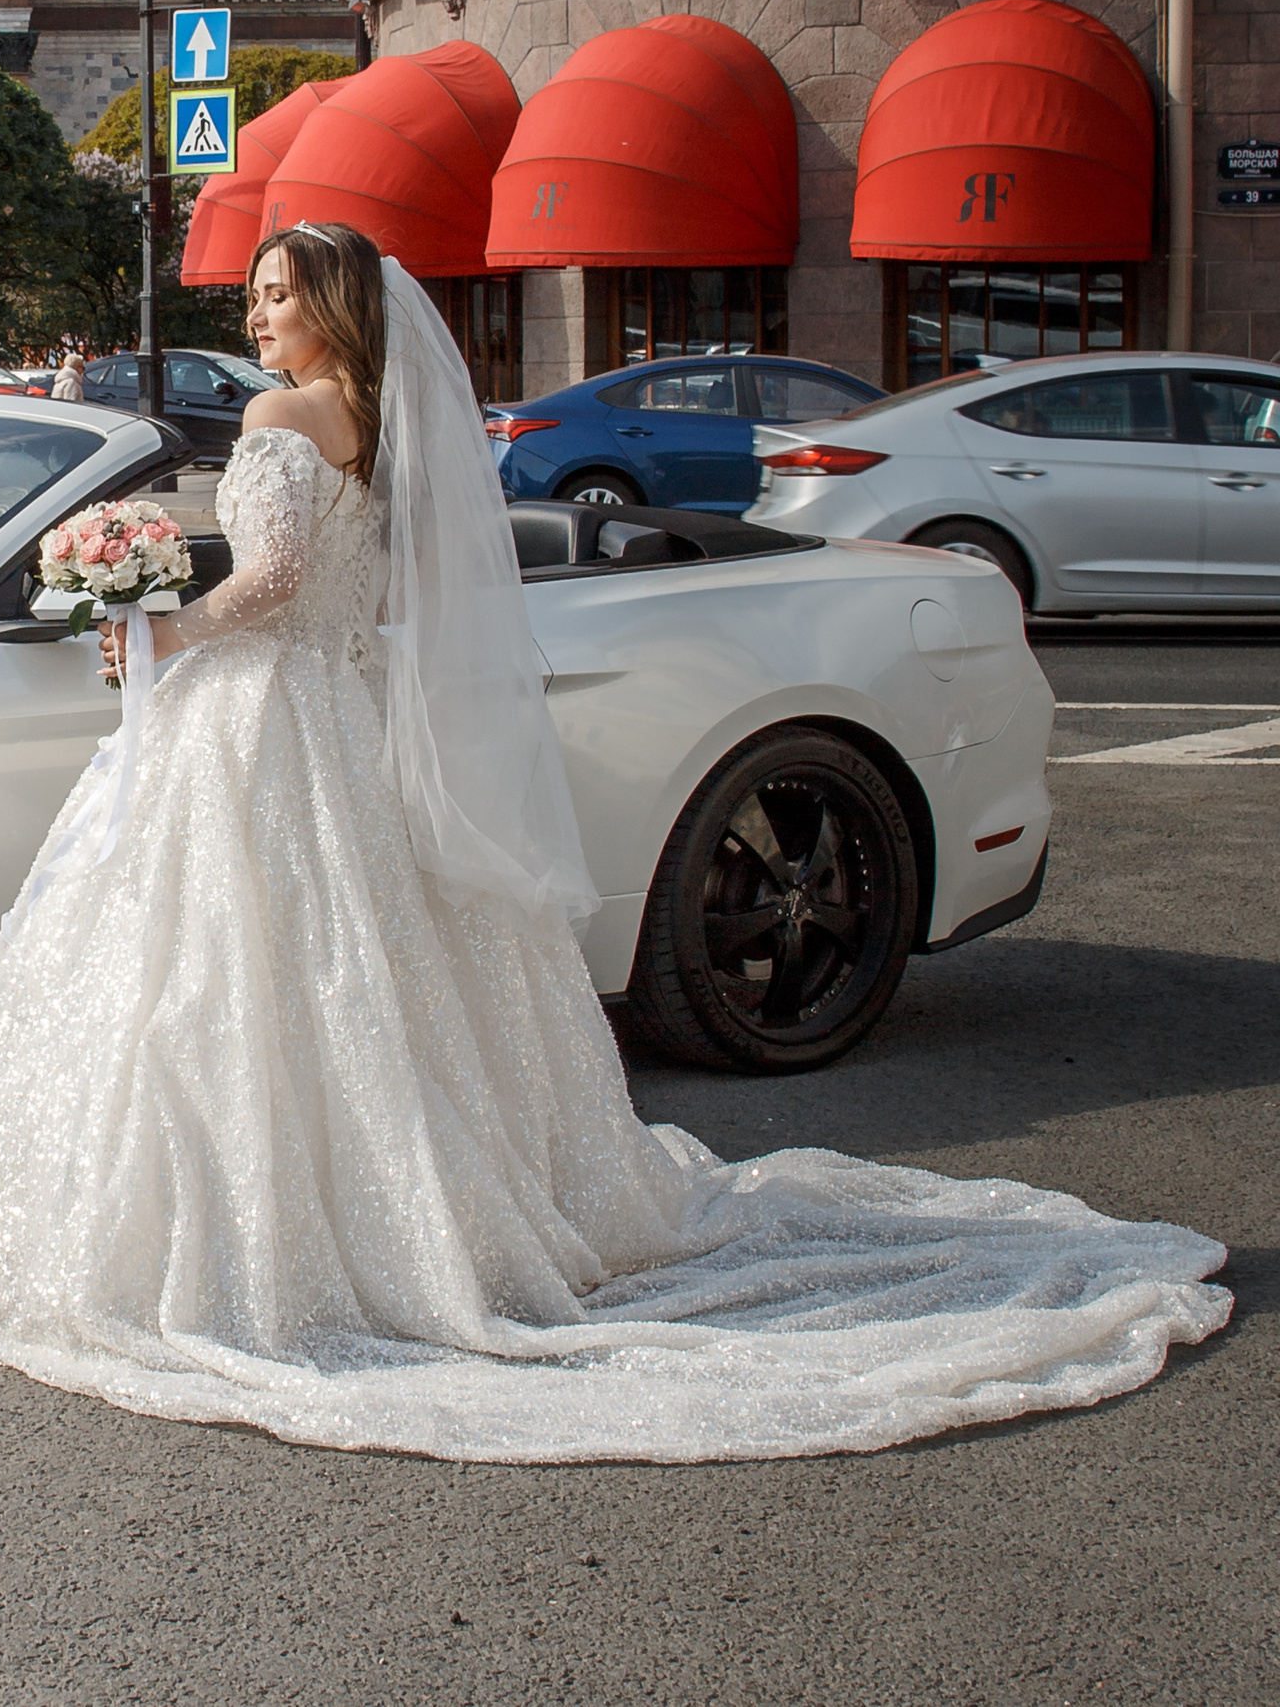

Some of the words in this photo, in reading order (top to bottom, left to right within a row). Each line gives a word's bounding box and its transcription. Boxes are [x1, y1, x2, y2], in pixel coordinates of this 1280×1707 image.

[1228, 149, 1279, 159] БОЛЬШАЯ
[1229, 159, 1277, 169] МОРСКАЯ
[1246, 191, 1259, 203] 39
